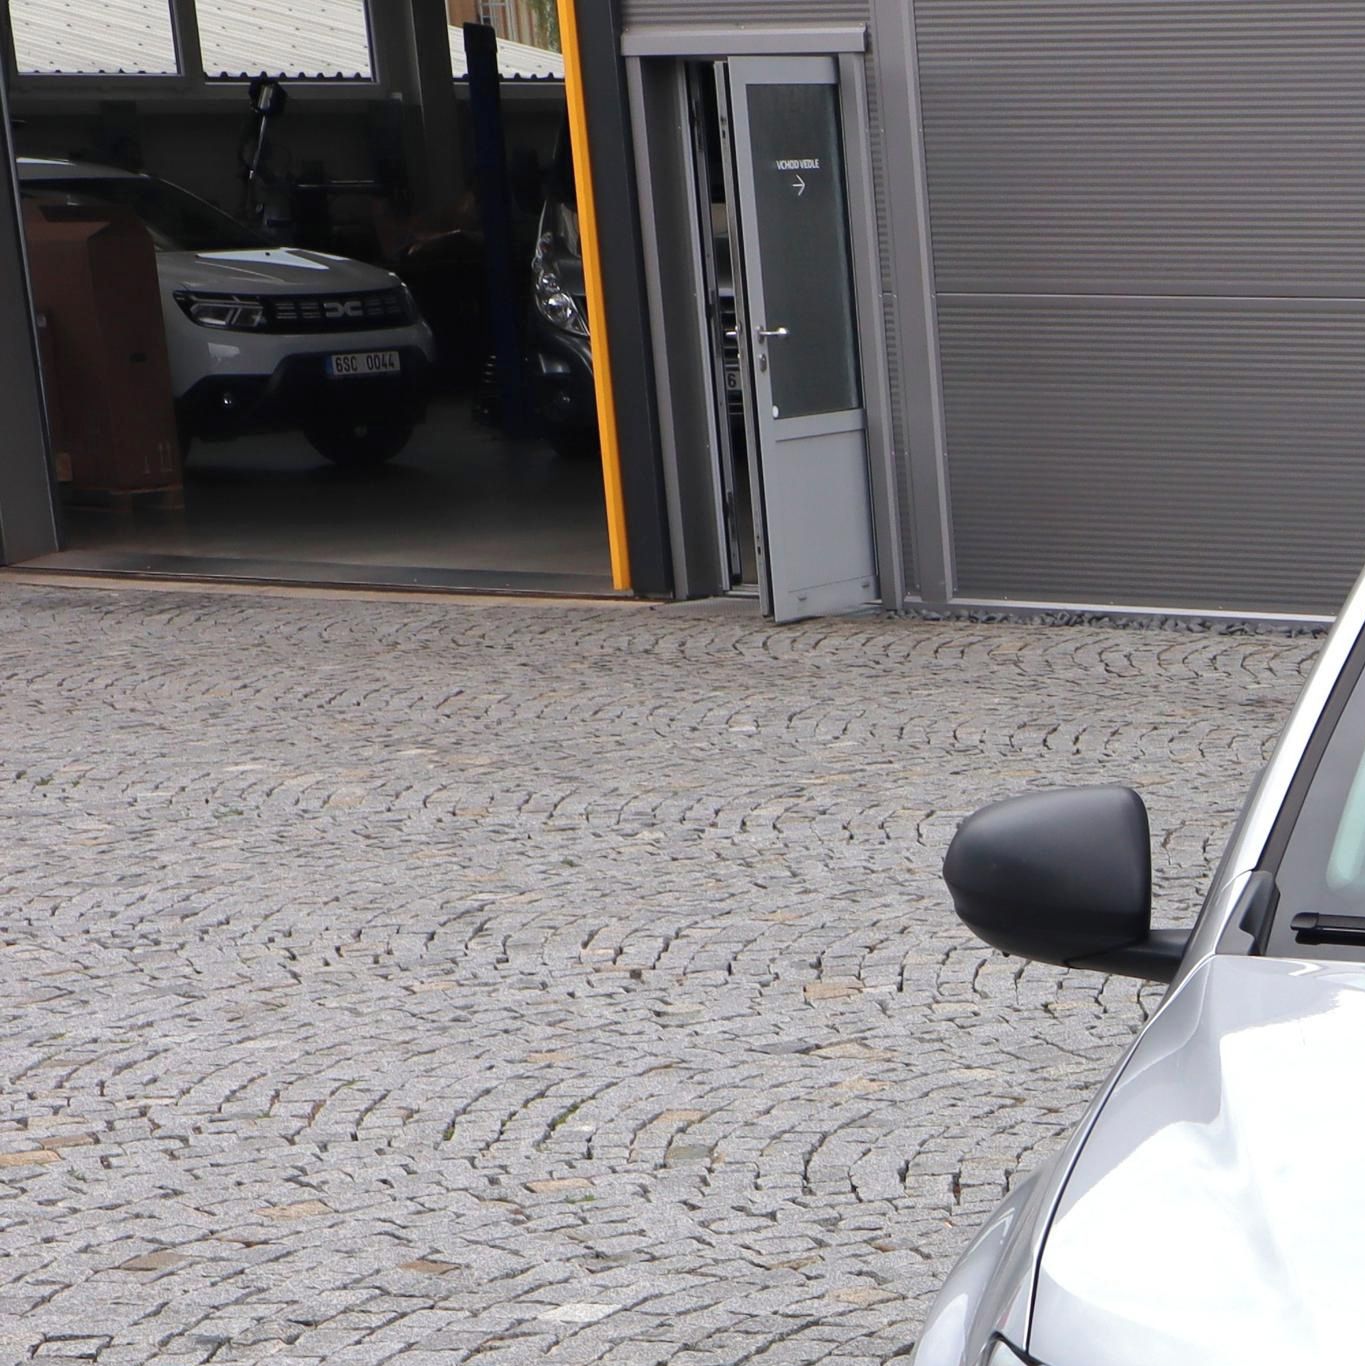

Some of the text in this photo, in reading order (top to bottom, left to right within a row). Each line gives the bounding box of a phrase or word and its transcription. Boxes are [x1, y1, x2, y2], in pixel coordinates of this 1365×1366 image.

[776, 158, 820, 170] VCHOD VEDLE
[366, 353, 395, 370] 0044
